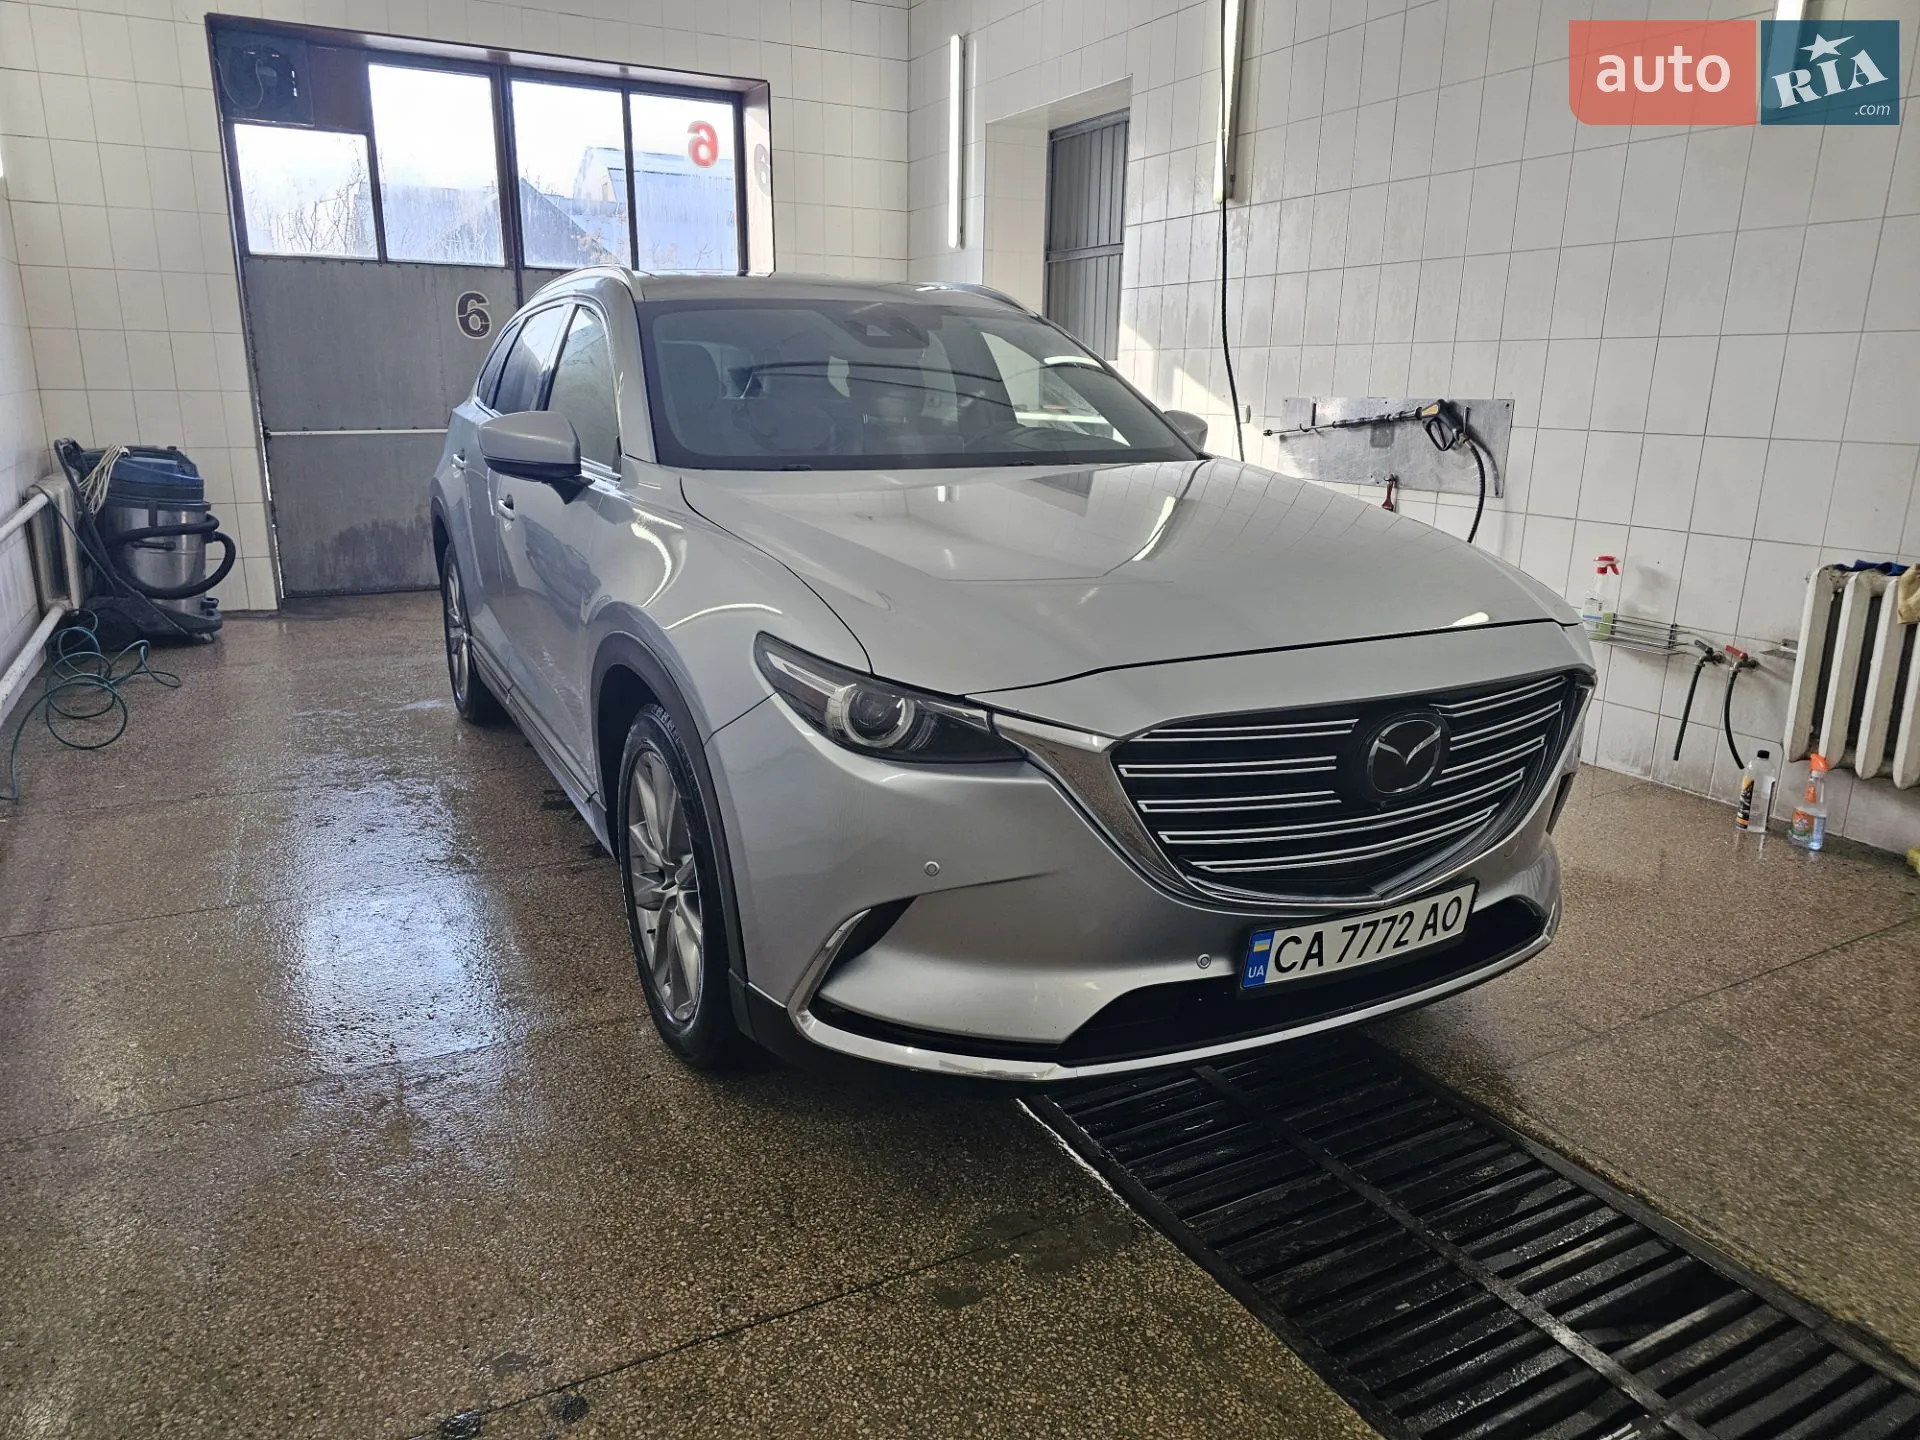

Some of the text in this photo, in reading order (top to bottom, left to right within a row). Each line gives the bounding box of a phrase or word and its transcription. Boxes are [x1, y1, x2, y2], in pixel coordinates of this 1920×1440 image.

[456, 290, 492, 339] 6
[1274, 896, 1462, 974] CA 7772 AO
[1248, 964, 1265, 979] UA
